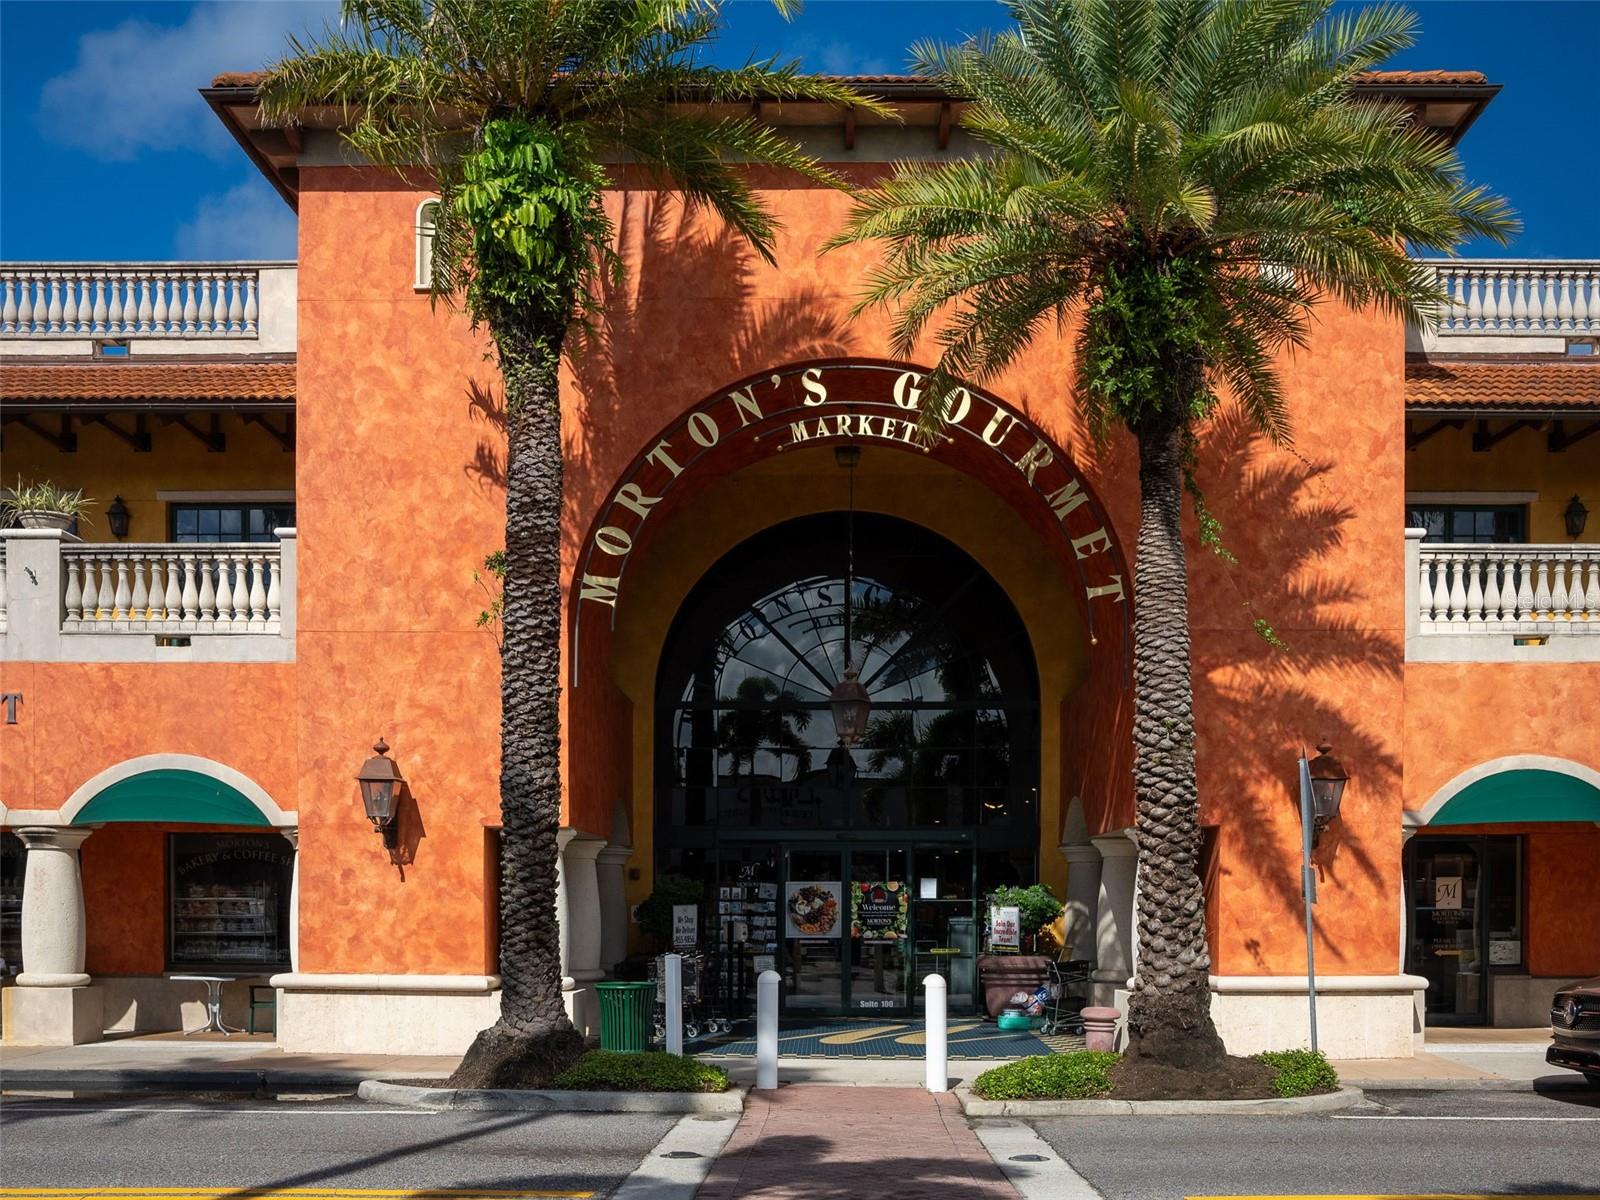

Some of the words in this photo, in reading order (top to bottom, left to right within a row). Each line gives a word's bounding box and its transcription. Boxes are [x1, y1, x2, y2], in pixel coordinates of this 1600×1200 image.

[790, 414, 918, 443] MARKET
[579, 368, 827, 608] MORTON'S
[893, 372, 1126, 603] GOURMET
[178, 852, 219, 875] BAKERY
[233, 849, 278, 863] COFFEE
[1435, 879, 1463, 903] M
[860, 1000, 878, 1008] Suite
[881, 1000, 893, 1008] 100
